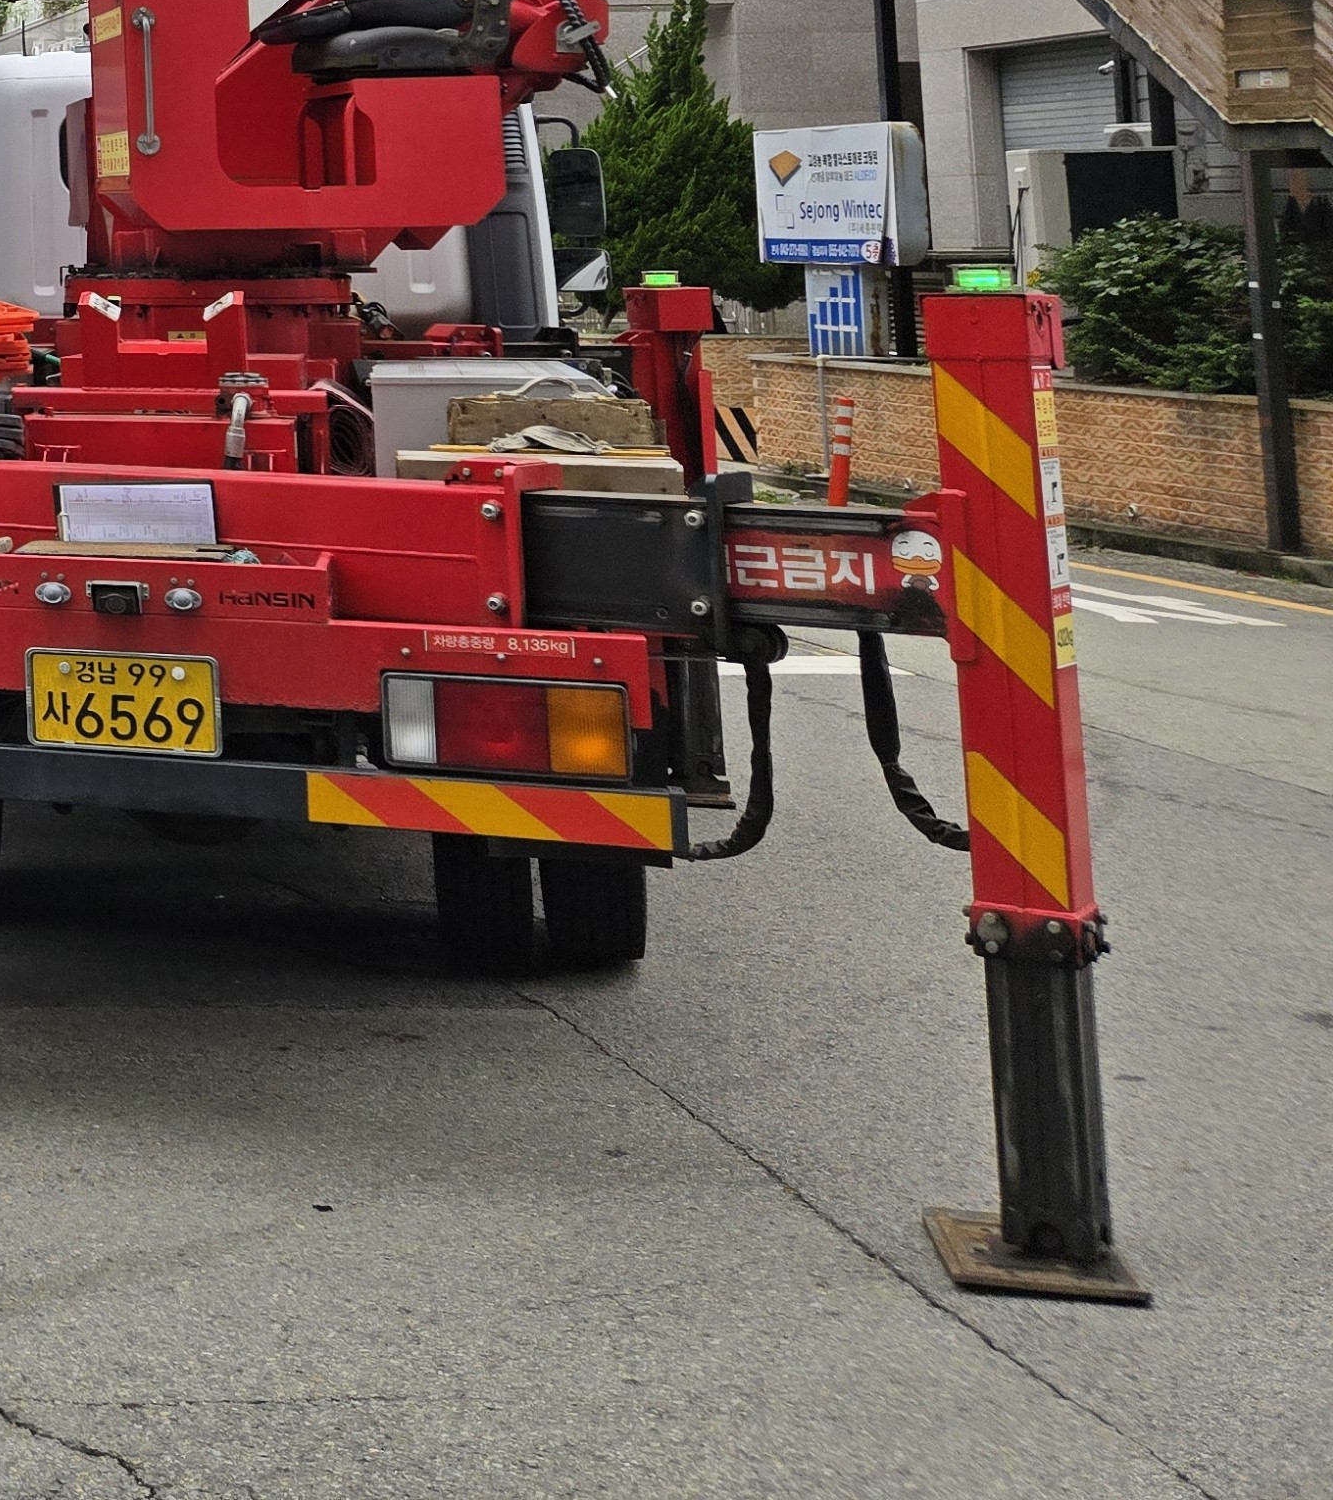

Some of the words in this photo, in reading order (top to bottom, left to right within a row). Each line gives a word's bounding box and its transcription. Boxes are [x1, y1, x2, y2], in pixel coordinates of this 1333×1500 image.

[799, 200, 840, 223] Sejong
[842, 198, 883, 220] Wintec
[724, 543, 876, 595] 근금지
[432, 635, 495, 650] 차량총중량
[74, 660, 117, 686] 경남
[127, 662, 167, 688] 99
